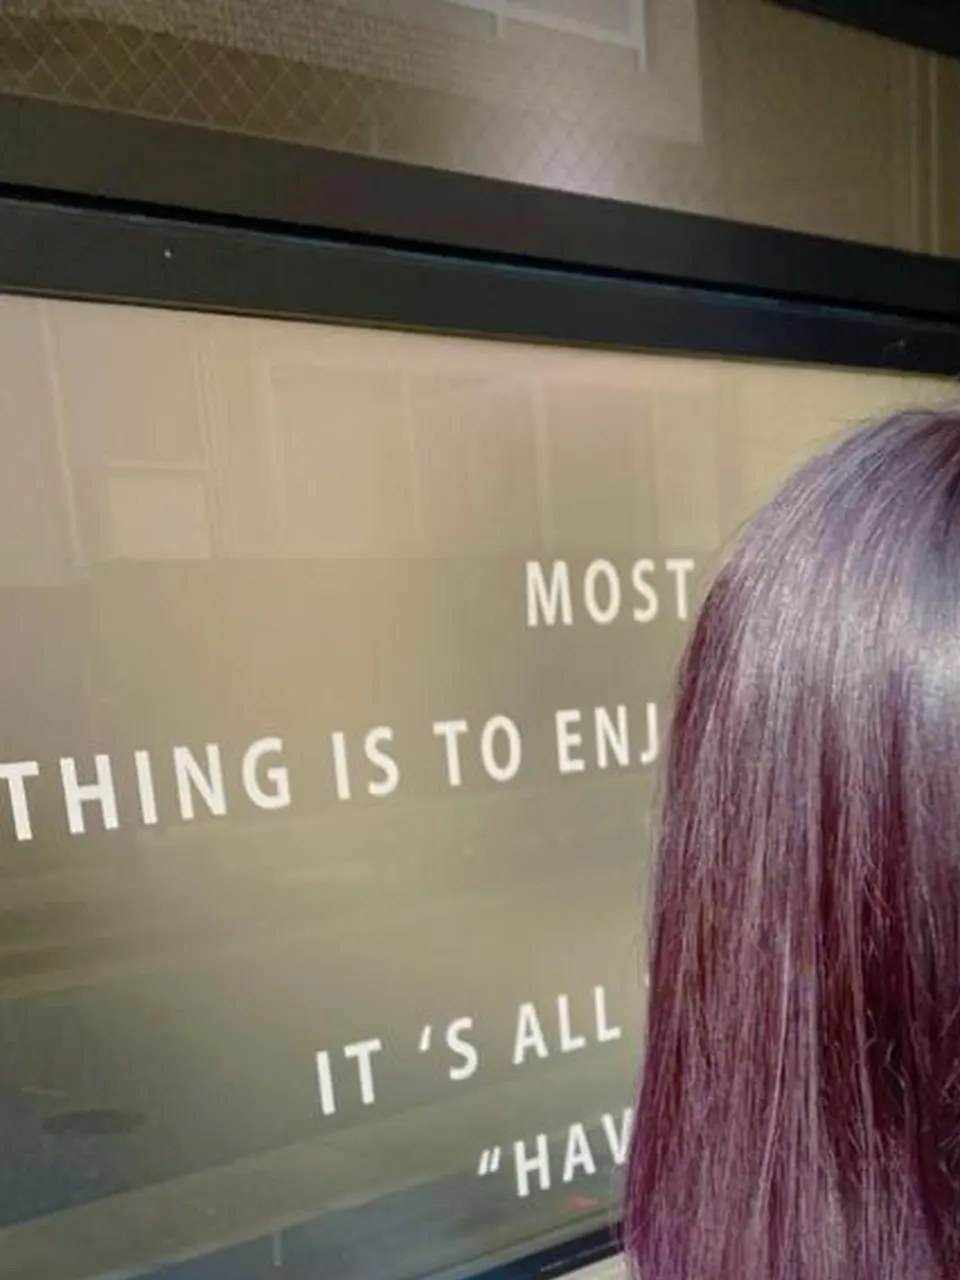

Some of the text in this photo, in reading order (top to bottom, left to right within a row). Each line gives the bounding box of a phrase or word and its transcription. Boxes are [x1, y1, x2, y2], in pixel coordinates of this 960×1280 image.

[526, 558, 695, 627] MOST
[0, 736, 292, 841] THING
[331, 725, 400, 801] IS
[432, 715, 521, 787] TO
[513, 985, 622, 1065] ALL
